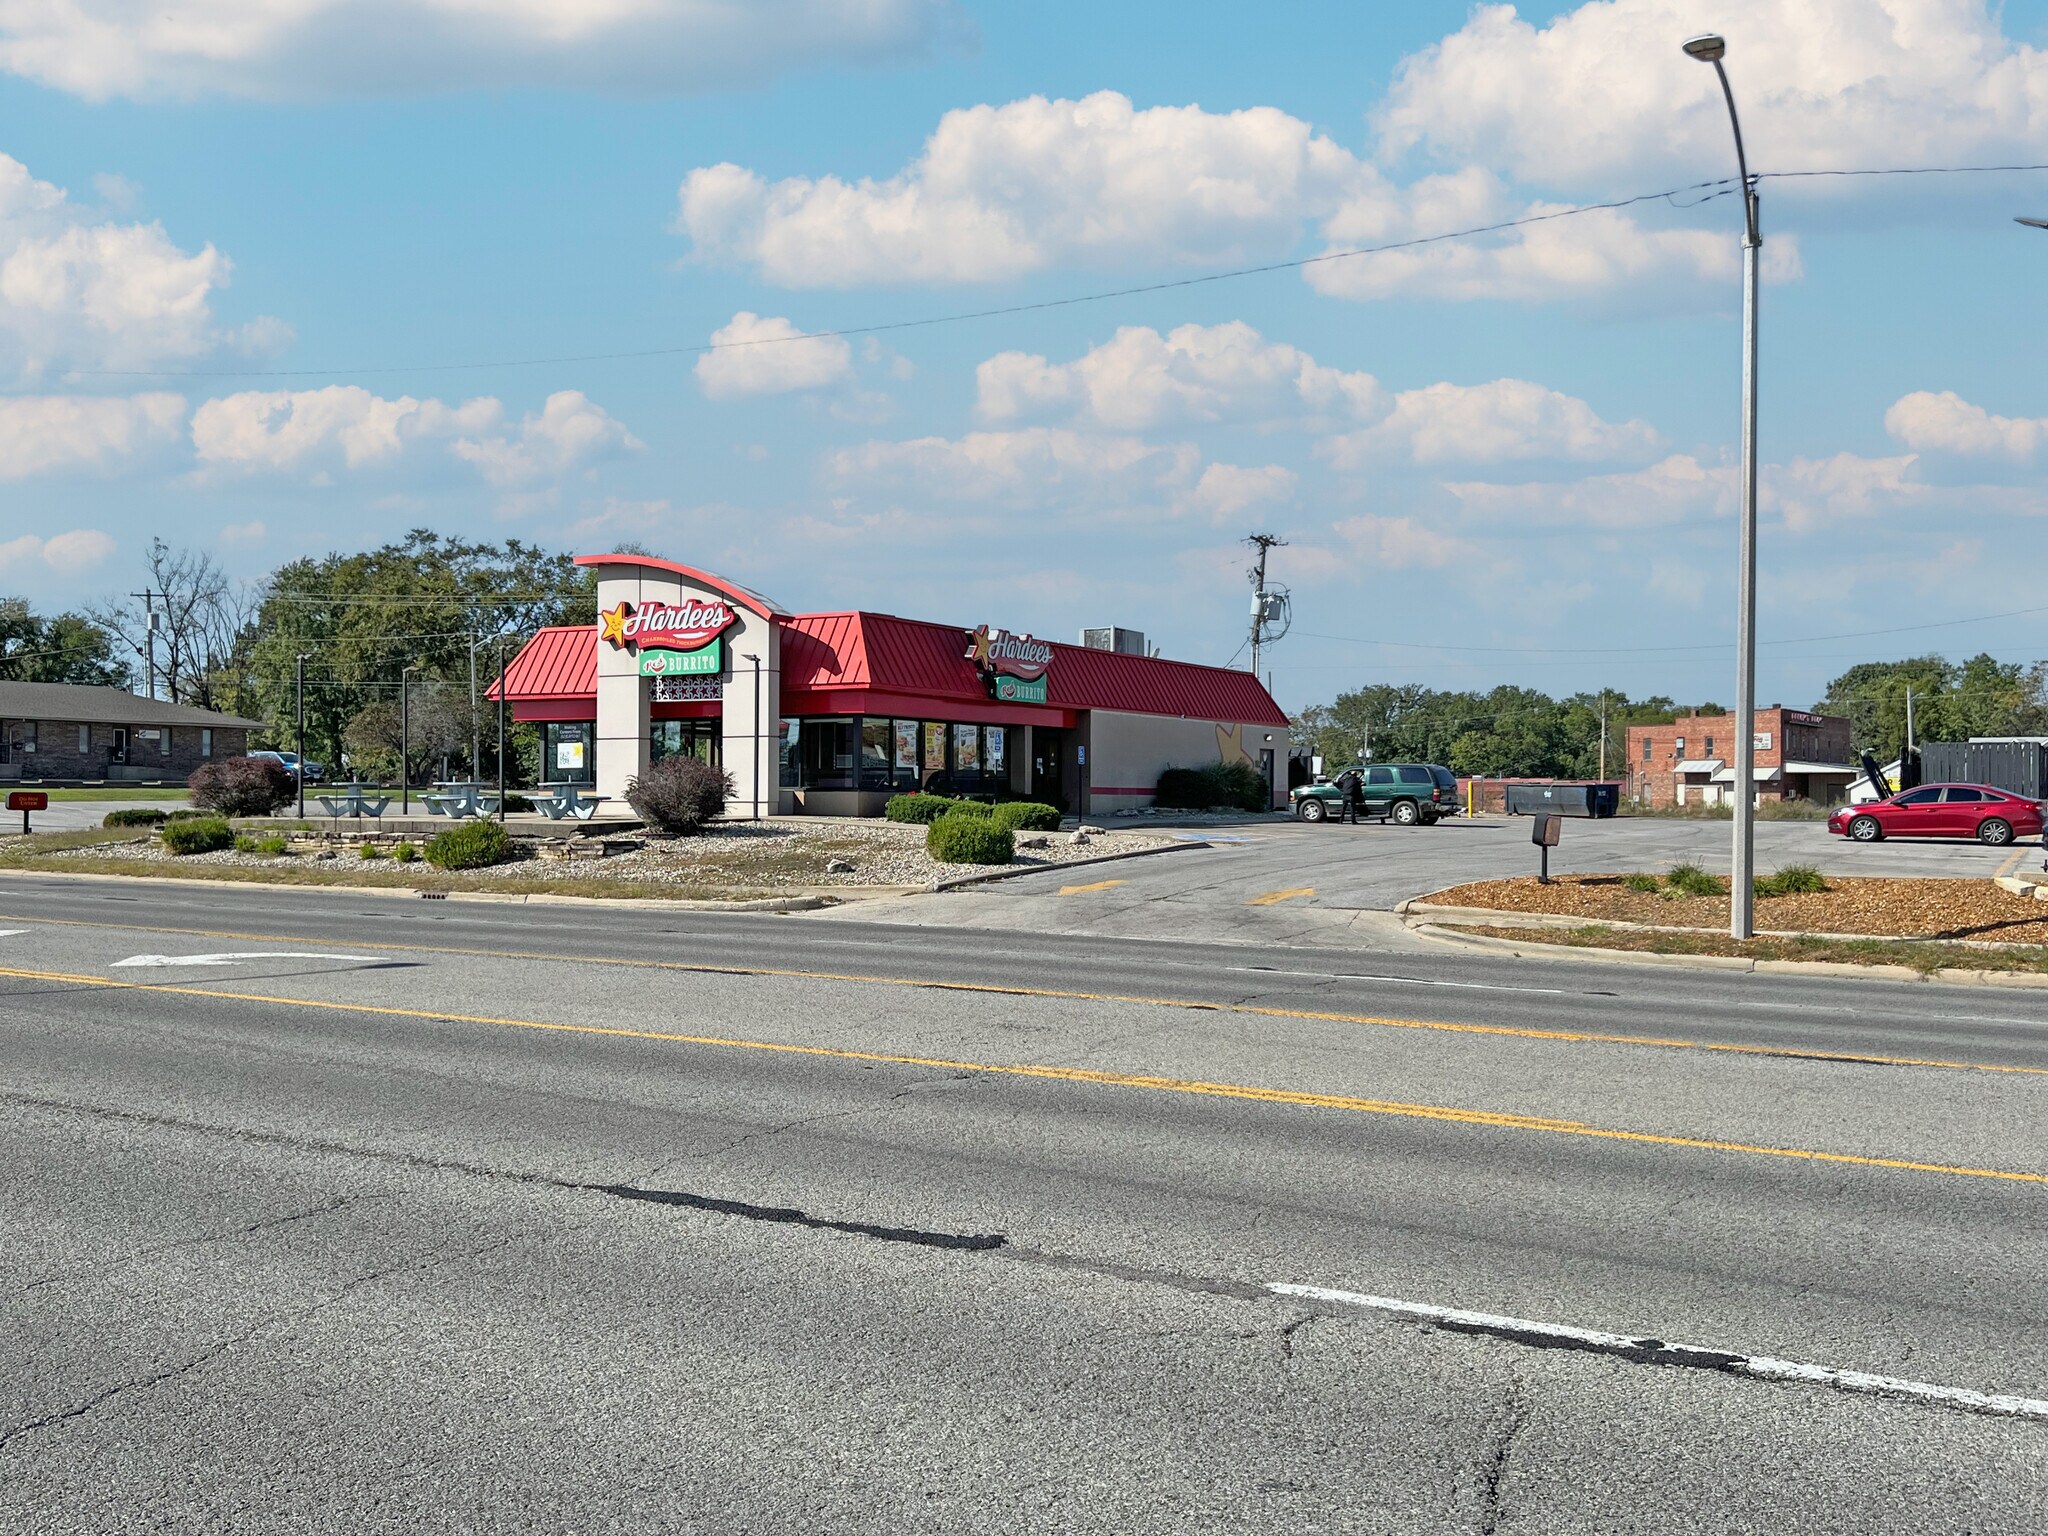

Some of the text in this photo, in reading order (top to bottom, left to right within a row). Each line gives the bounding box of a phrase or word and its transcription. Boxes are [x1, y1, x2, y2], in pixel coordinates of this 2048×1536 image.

[623, 601, 731, 636] Hardee's
[988, 631, 1054, 664] Hardee's
[669, 655, 715, 671] BURRITO
[1016, 685, 1045, 700] BURRITO
